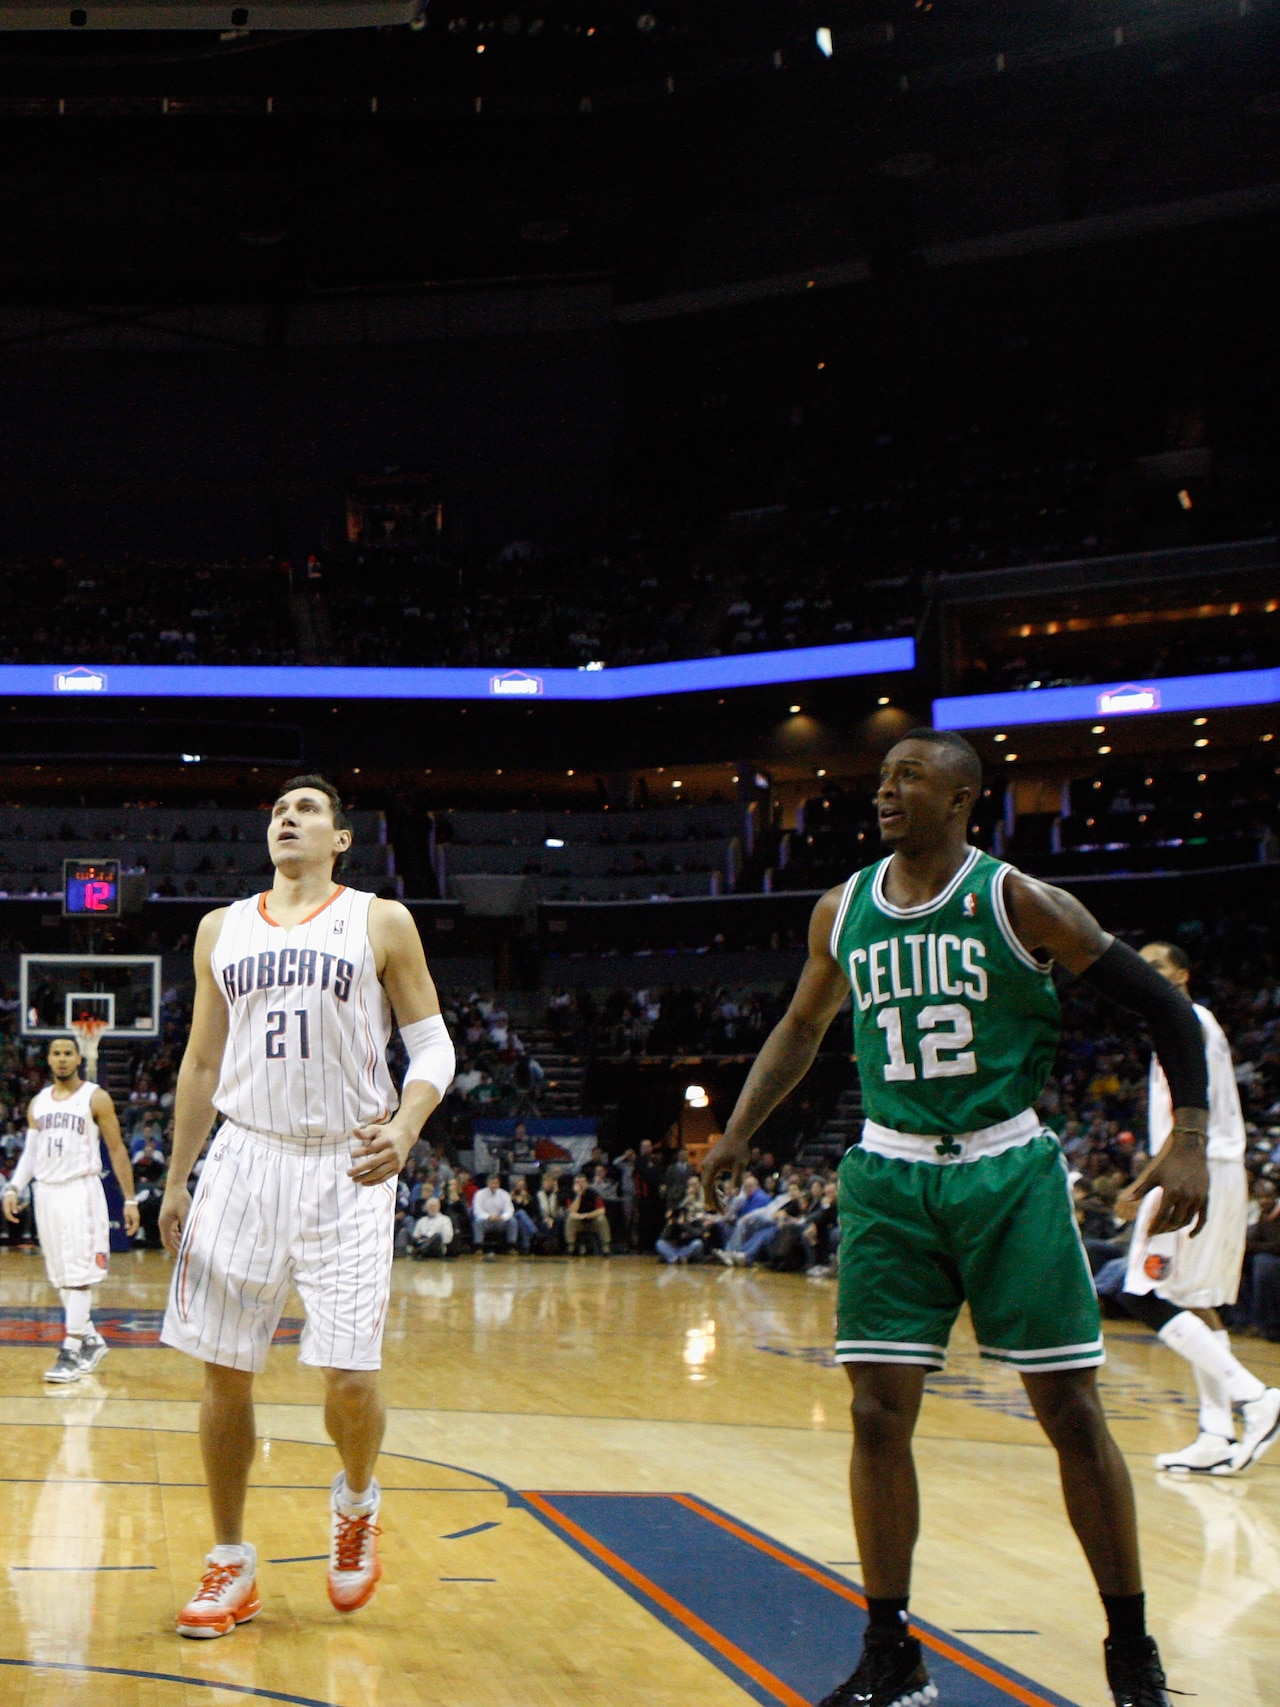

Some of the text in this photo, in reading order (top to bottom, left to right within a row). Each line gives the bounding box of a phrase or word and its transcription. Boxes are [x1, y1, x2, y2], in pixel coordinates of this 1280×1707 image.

[85, 881, 110, 910] 12
[222, 948, 354, 1006] BOBCATS
[848, 933, 988, 1012] CELTICS
[265, 1008, 310, 1060] 21
[876, 1003, 978, 1081] 12
[48, 1136, 63, 1158] 14
